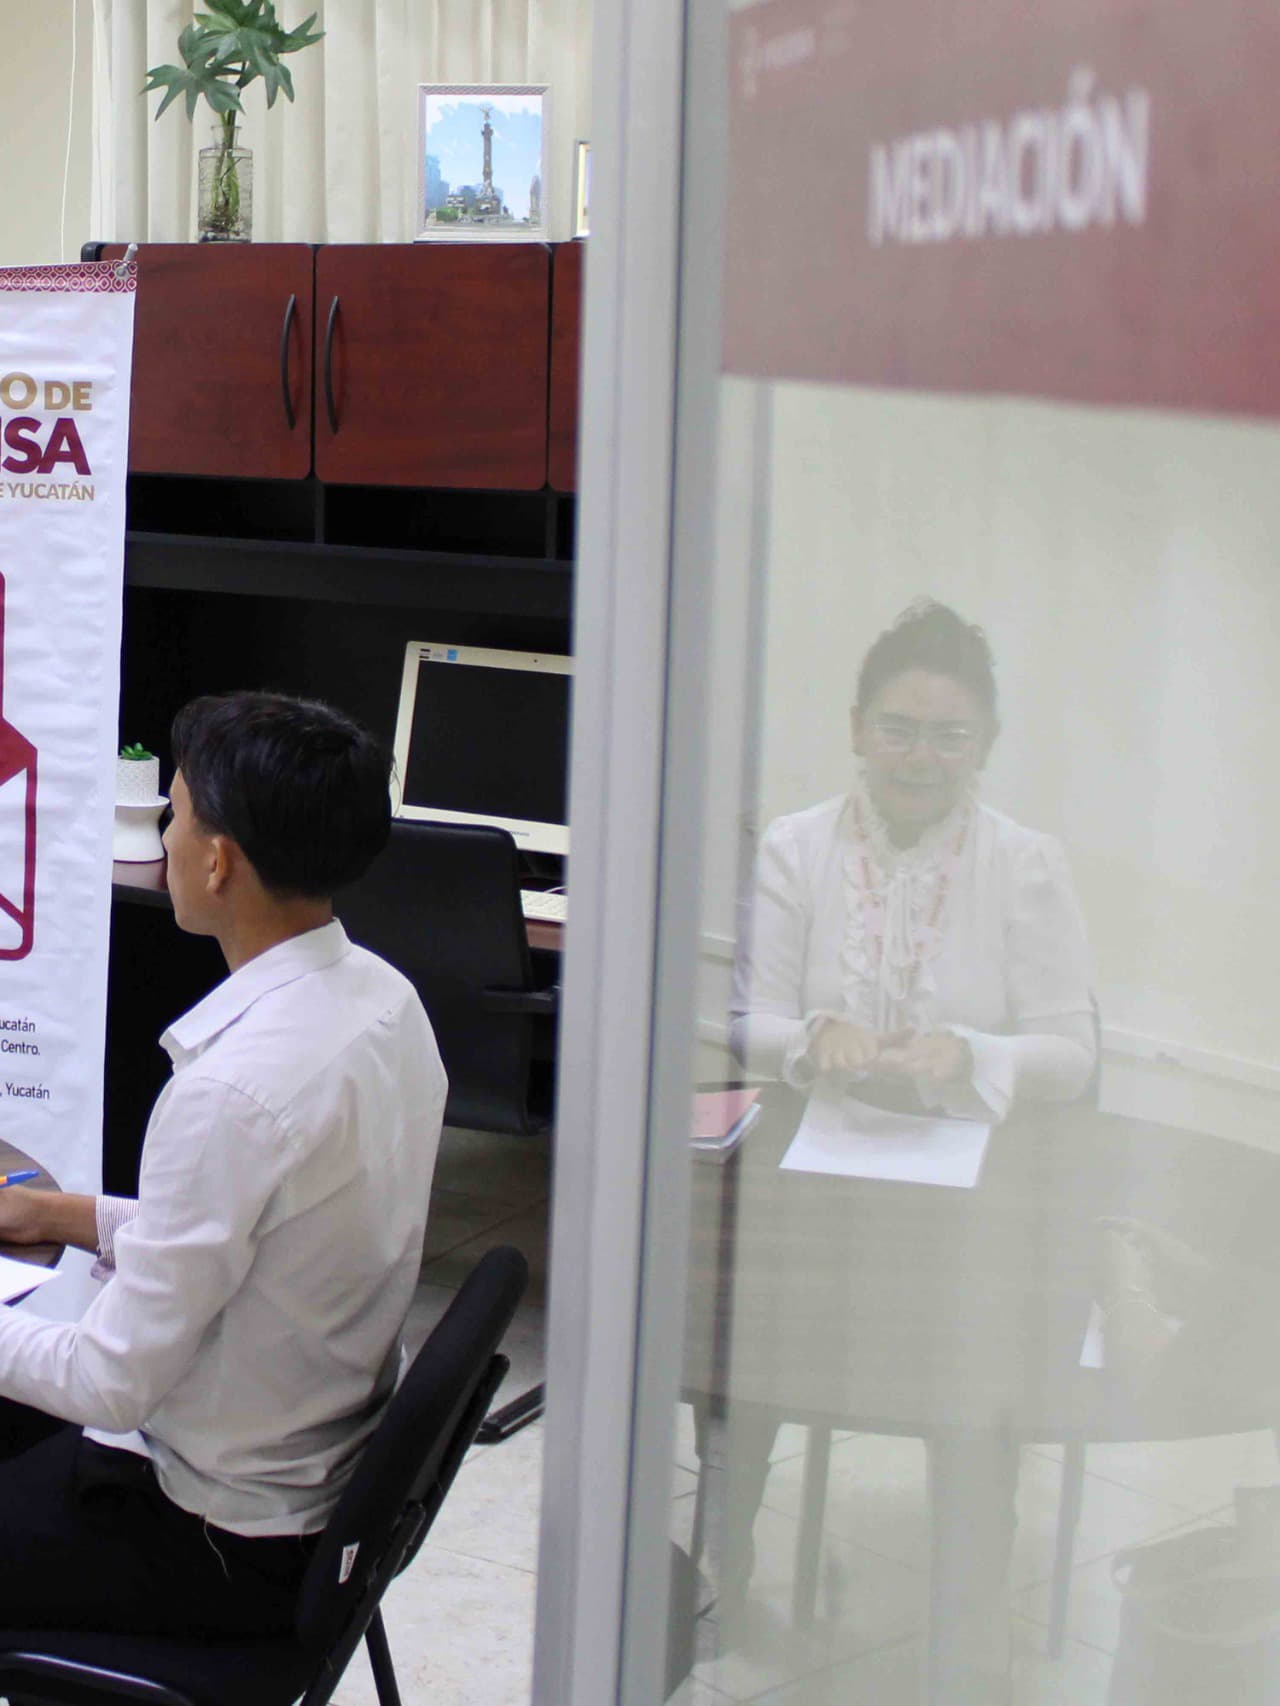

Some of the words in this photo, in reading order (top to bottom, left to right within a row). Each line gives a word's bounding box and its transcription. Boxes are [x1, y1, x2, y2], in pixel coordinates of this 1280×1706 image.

[867, 66, 1150, 247] MEDIACIÓN
[44, 381, 93, 411] DE
[7, 480, 95, 502] YUCATÁN
[0, 1039, 41, 1056] Centro.
[5, 1082, 50, 1100] Yucatán
